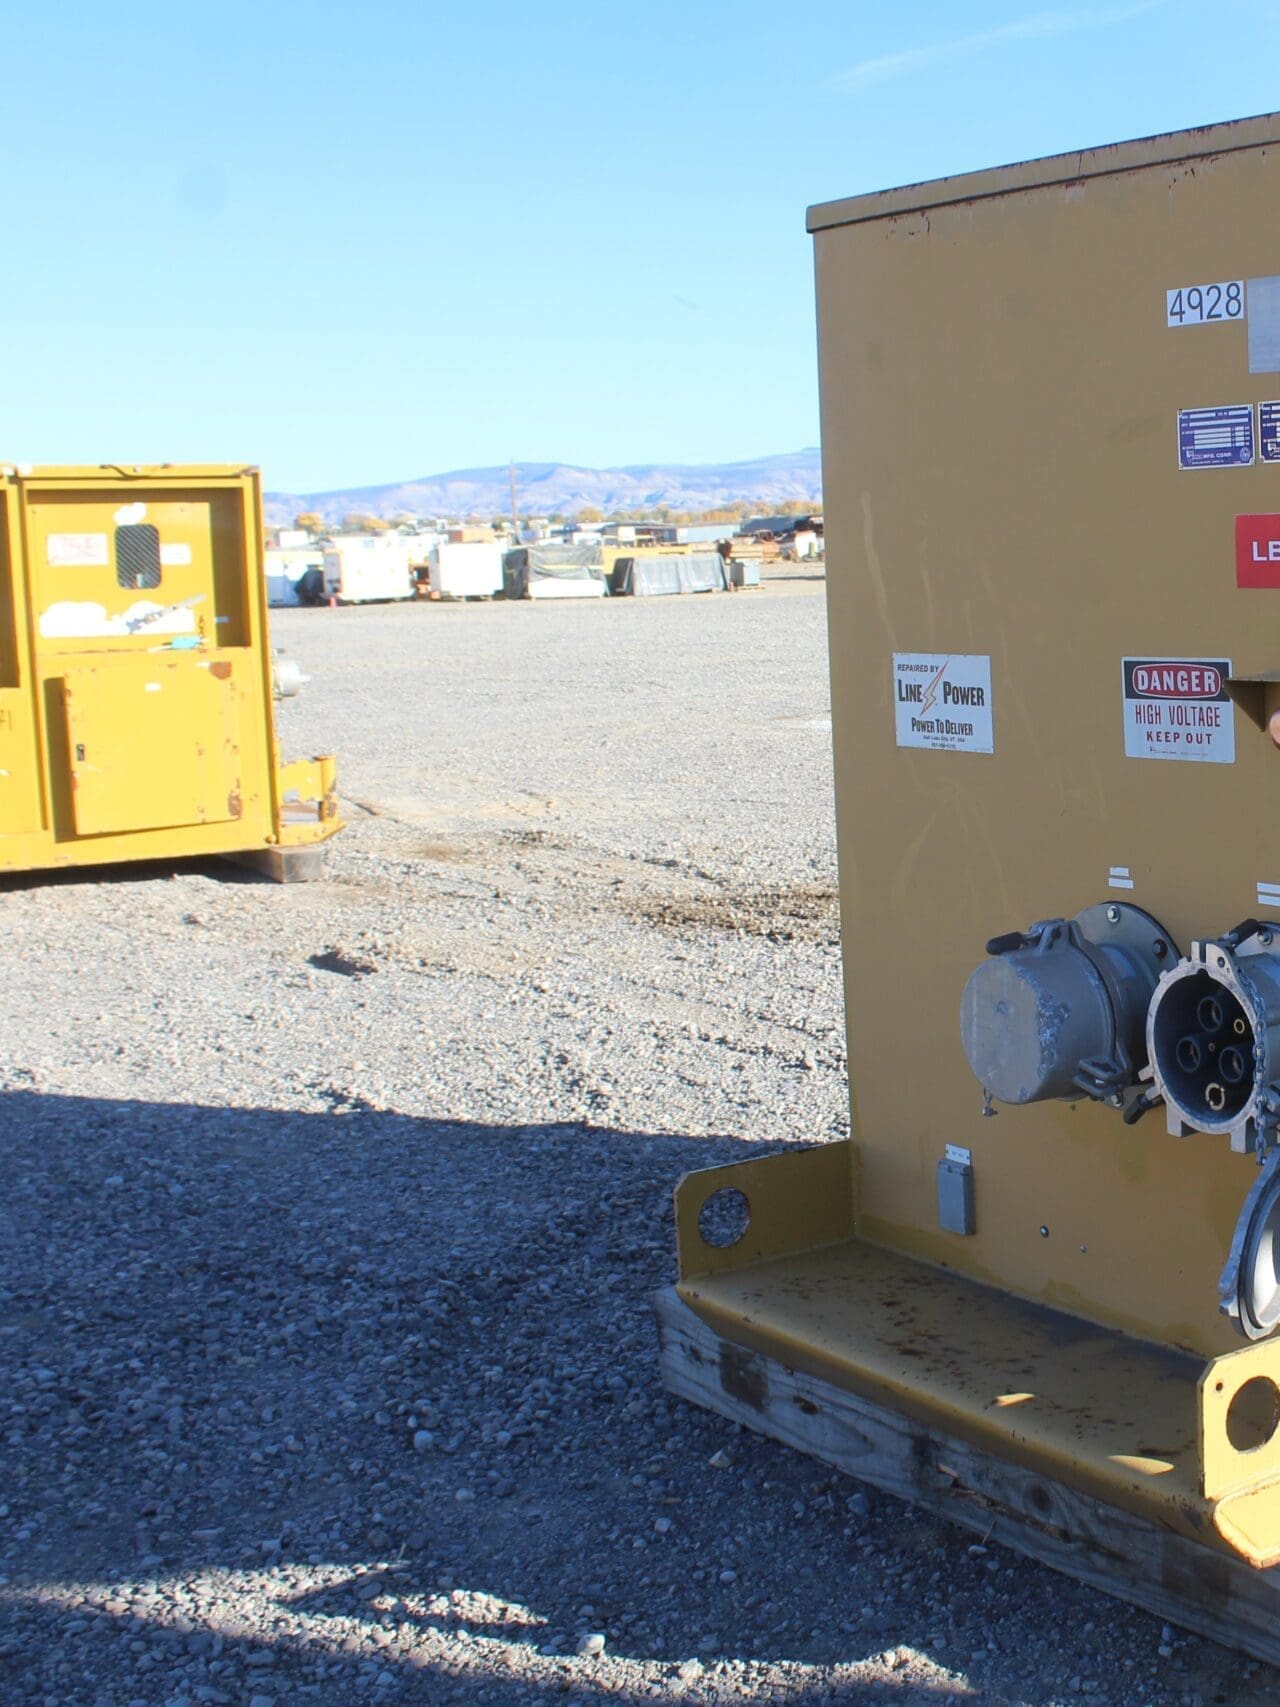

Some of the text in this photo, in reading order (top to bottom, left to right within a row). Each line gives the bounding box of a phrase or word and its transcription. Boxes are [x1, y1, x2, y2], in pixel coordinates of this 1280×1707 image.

[1169, 283, 1242, 323] 4928
[897, 664, 939, 673] REPAIRED BY
[898, 679, 985, 706] LINE POWER
[1137, 670, 1216, 693] DANGER
[911, 717, 974, 736] POWER TO DELIVER
[1135, 704, 1221, 727] HIGH VOLTAGE
[1146, 731, 1213, 745] KEEP OUT
